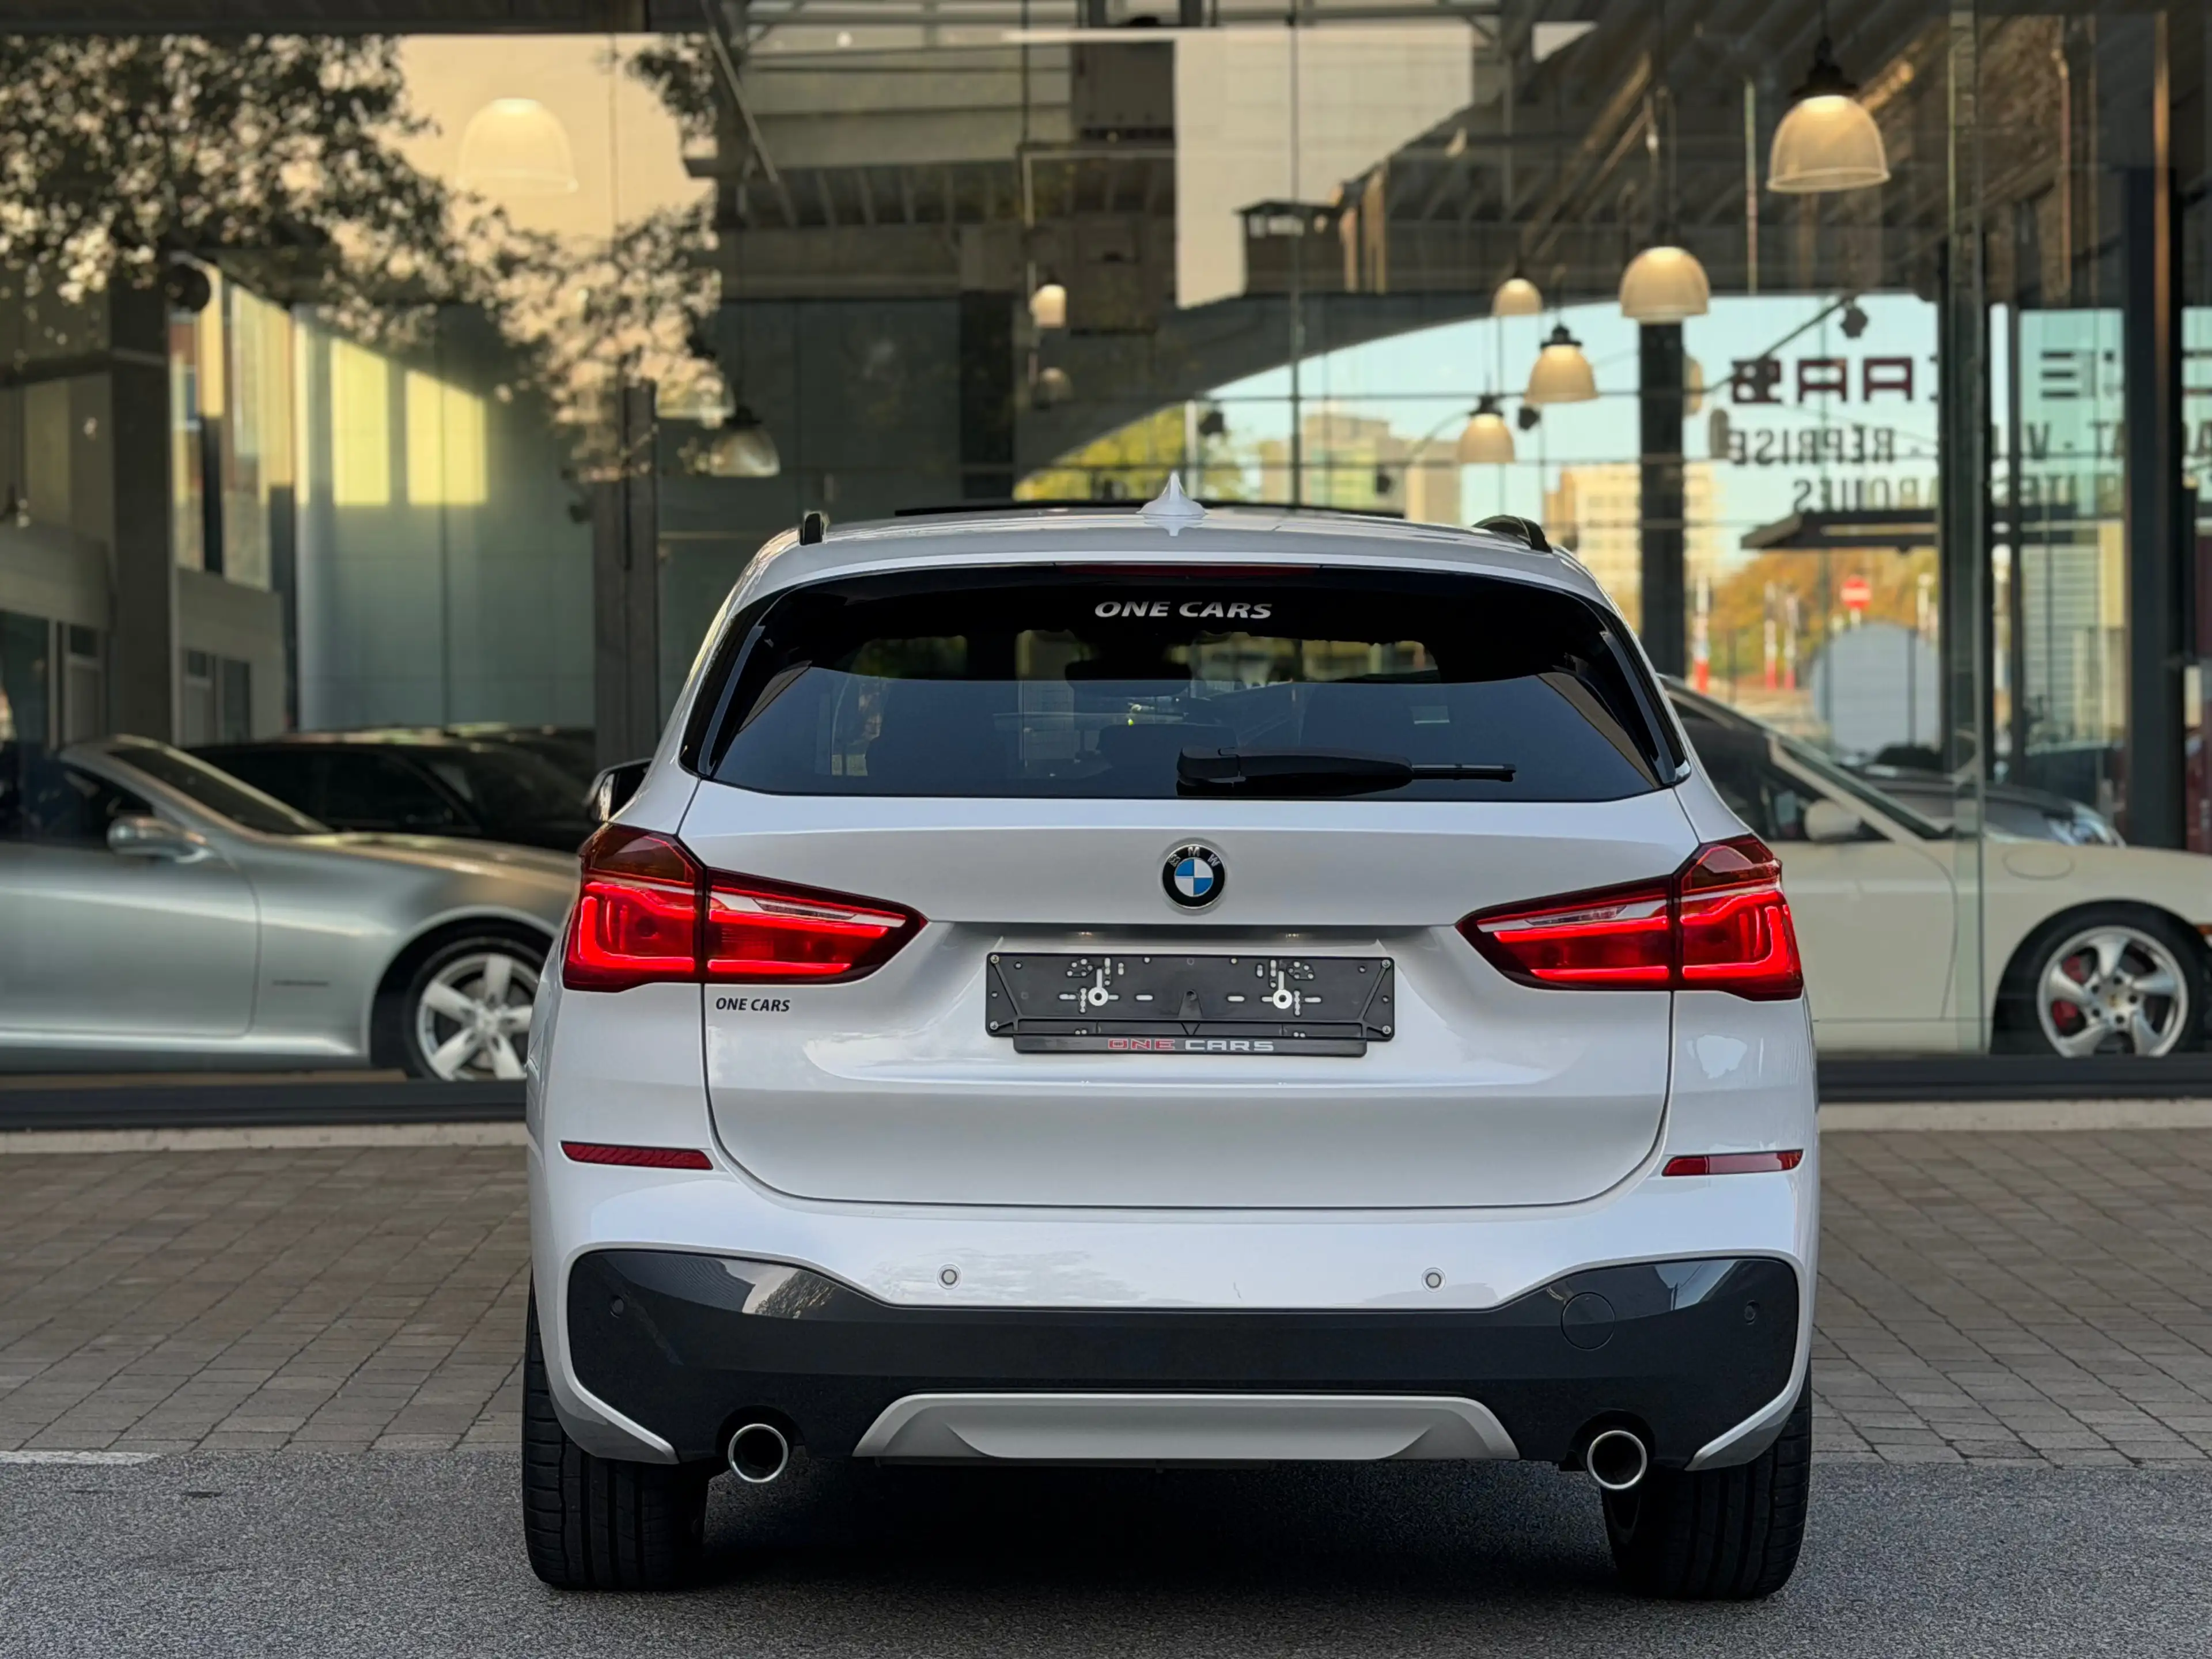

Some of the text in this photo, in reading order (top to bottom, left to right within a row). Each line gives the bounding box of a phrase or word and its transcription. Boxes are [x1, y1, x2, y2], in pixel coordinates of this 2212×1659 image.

[1094, 601, 1272, 619] ONE CARS
[1167, 846, 1221, 868] BMW
[715, 997, 791, 1012] ONE CARS
[1107, 1037, 1275, 1052] ONE CARS
